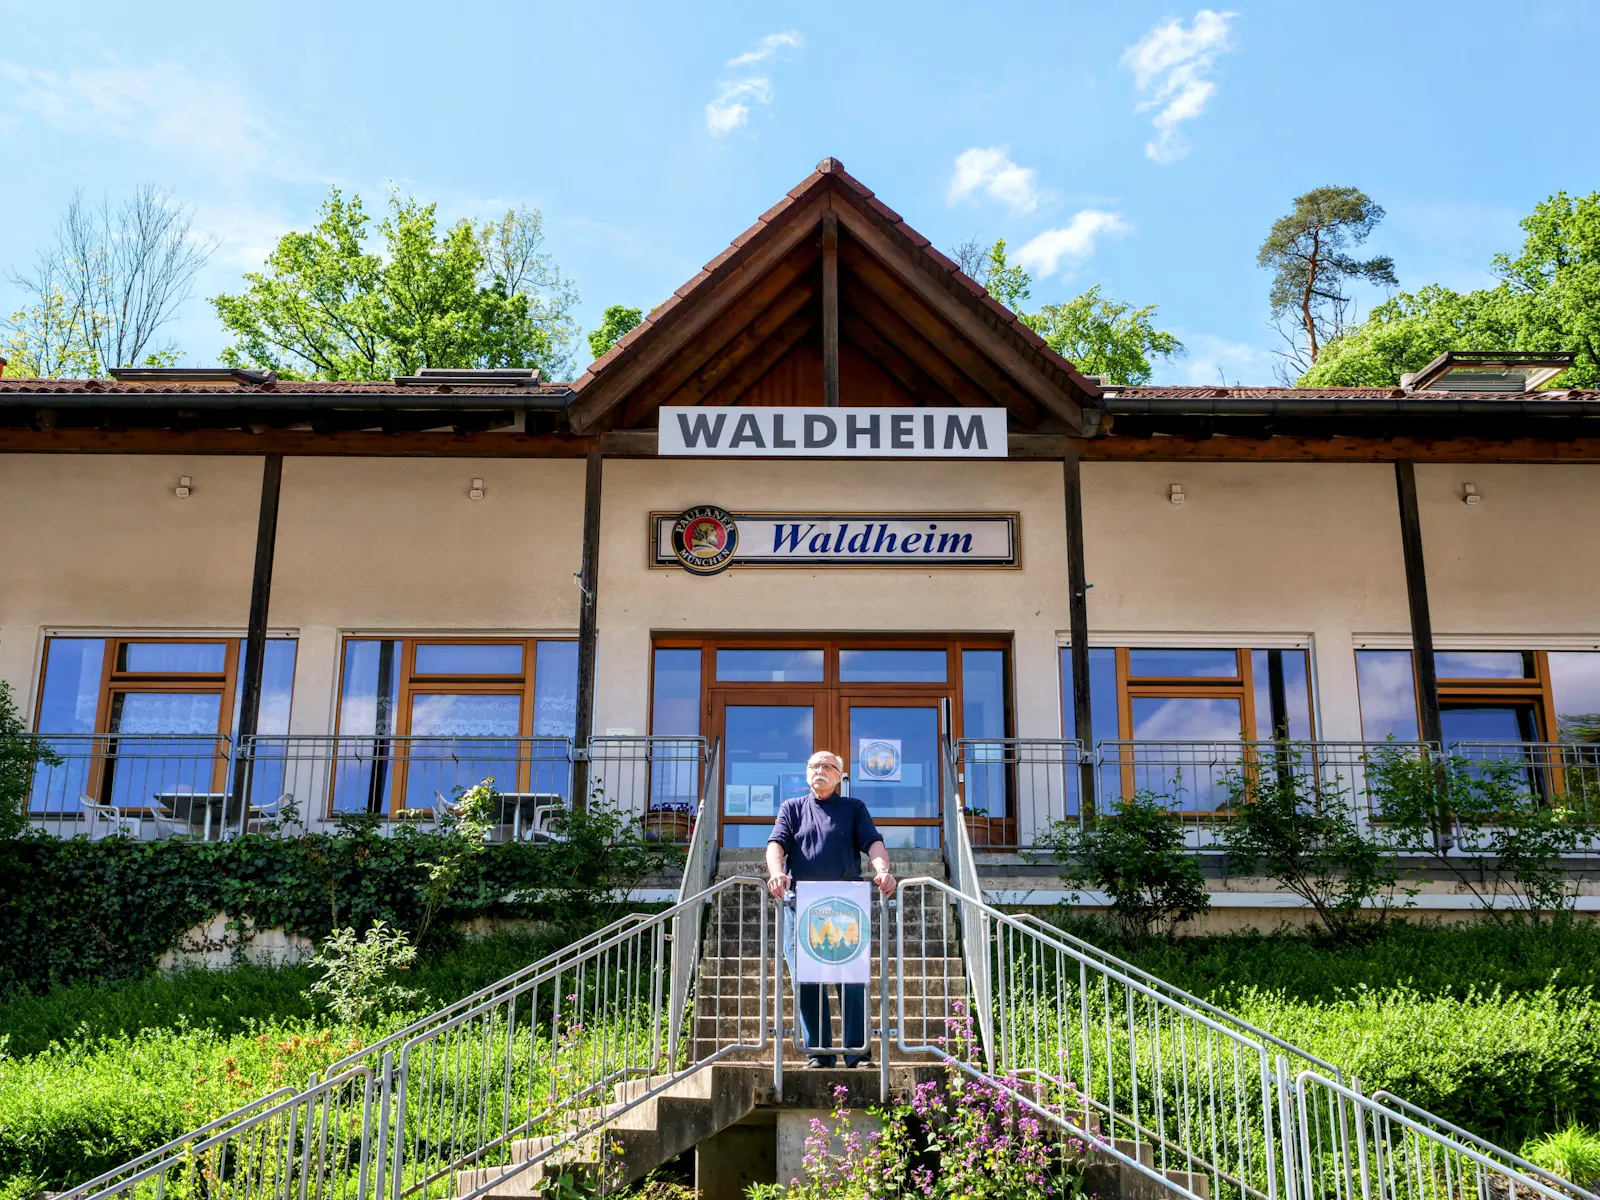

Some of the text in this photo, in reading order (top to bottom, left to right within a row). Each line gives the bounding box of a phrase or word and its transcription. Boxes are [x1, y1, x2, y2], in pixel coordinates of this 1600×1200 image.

[676, 413, 989, 450] WALDHEIM
[675, 508, 735, 533] PAULANER
[772, 523, 973, 554] Waldheim
[679, 548, 731, 567] MÜNCHEN
